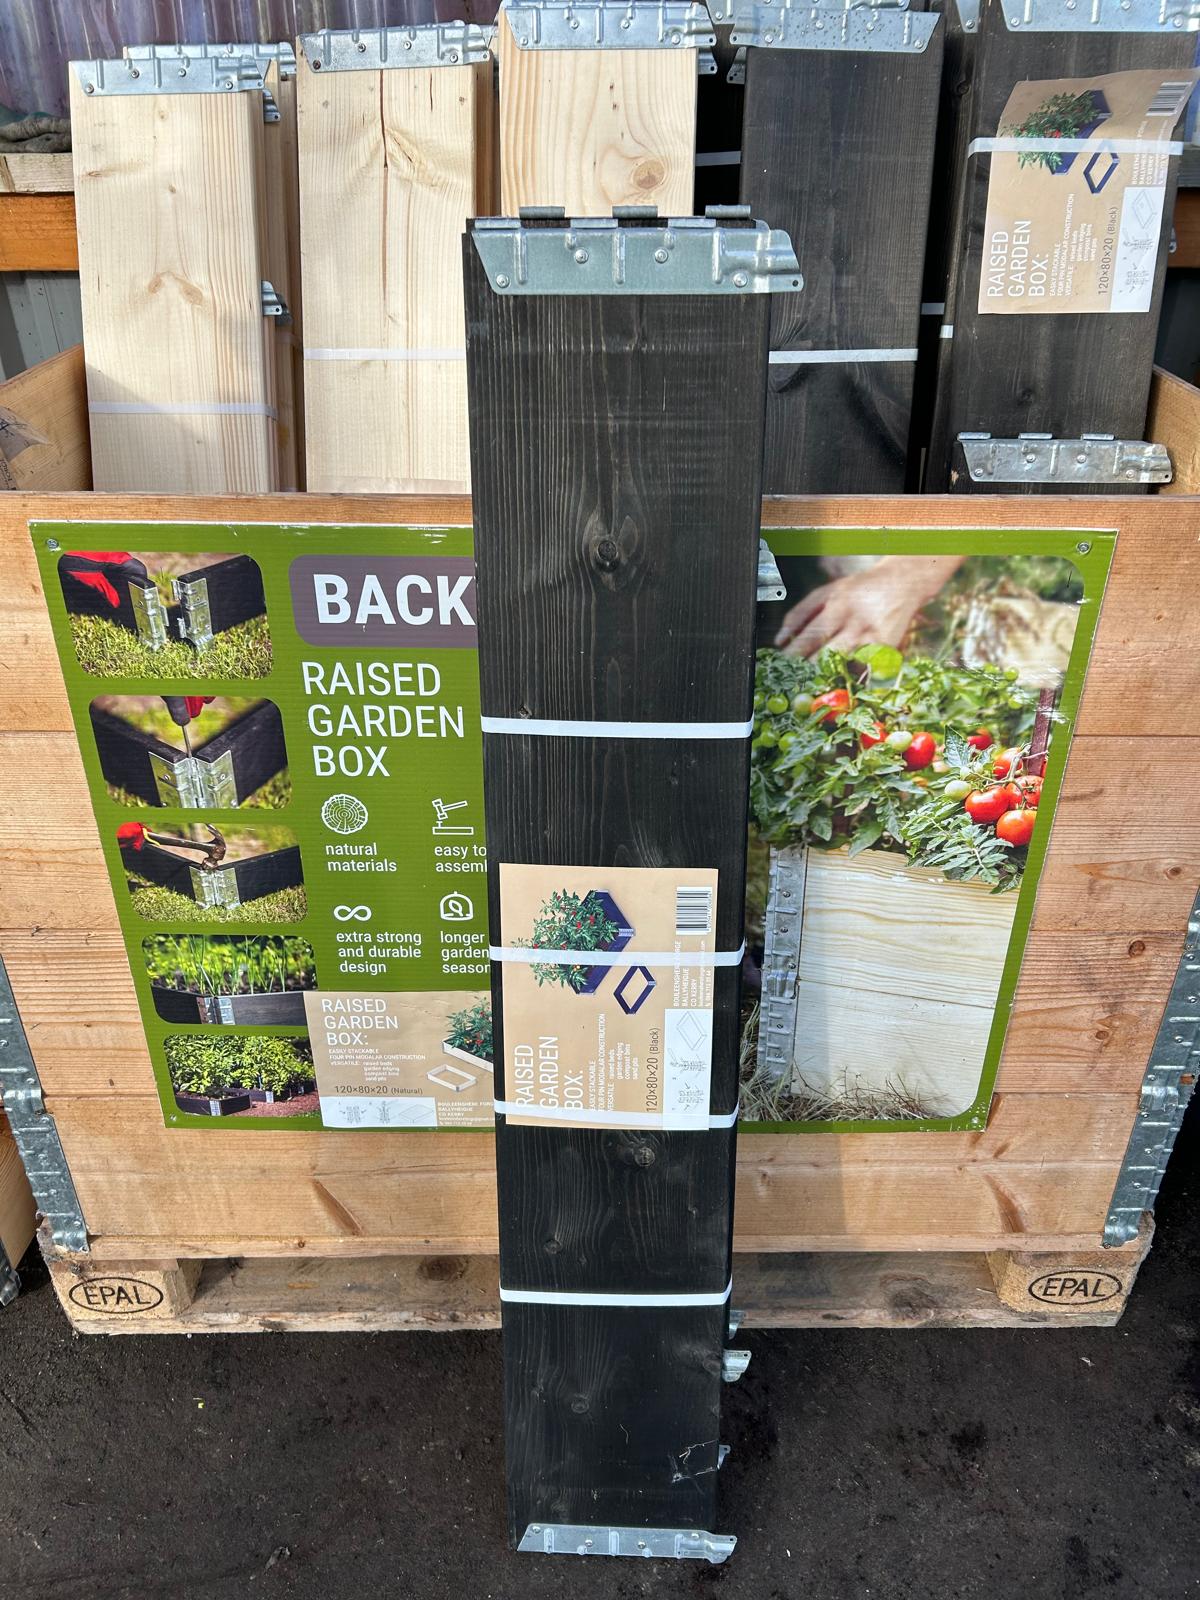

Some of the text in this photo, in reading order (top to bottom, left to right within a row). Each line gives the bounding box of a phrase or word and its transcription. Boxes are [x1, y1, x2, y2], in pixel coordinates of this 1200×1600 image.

[1063, 193, 1075, 239] CONSTRUCTION
[1107, 206, 1118, 235] (Black)
[987, 231, 1008, 297] RAISED
[1007, 221, 1031, 297] GARDEN
[1028, 253, 1049, 297] BOX:
[313, 573, 476, 625] BACK
[302, 661, 441, 696] RAISED
[307, 704, 464, 738] GARDEN
[312, 745, 390, 777] BOX
[325, 842, 378, 856] natural
[434, 845, 487, 859] easy to
[327, 859, 397, 872] materials
[336, 932, 422, 946] extra strong
[338, 946, 422, 958] and durable
[440, 931, 485, 945] longer
[340, 961, 387, 975] design
[321, 999, 387, 1013] RAISED
[324, 1015, 399, 1029] GARDEN
[326, 1032, 369, 1046] BOX:
[649, 1027, 661, 1055] (Black)
[514, 1045, 534, 1108] RAISED
[538, 1036, 559, 1109] GARDEN
[588, 1060, 596, 1092] STACKABLE
[390, 1087, 424, 1095] (Natural)
[564, 1069, 583, 1110] BOX:
[83, 1286, 151, 1305] EPAL
[1042, 1277, 1106, 1297] EPAL
